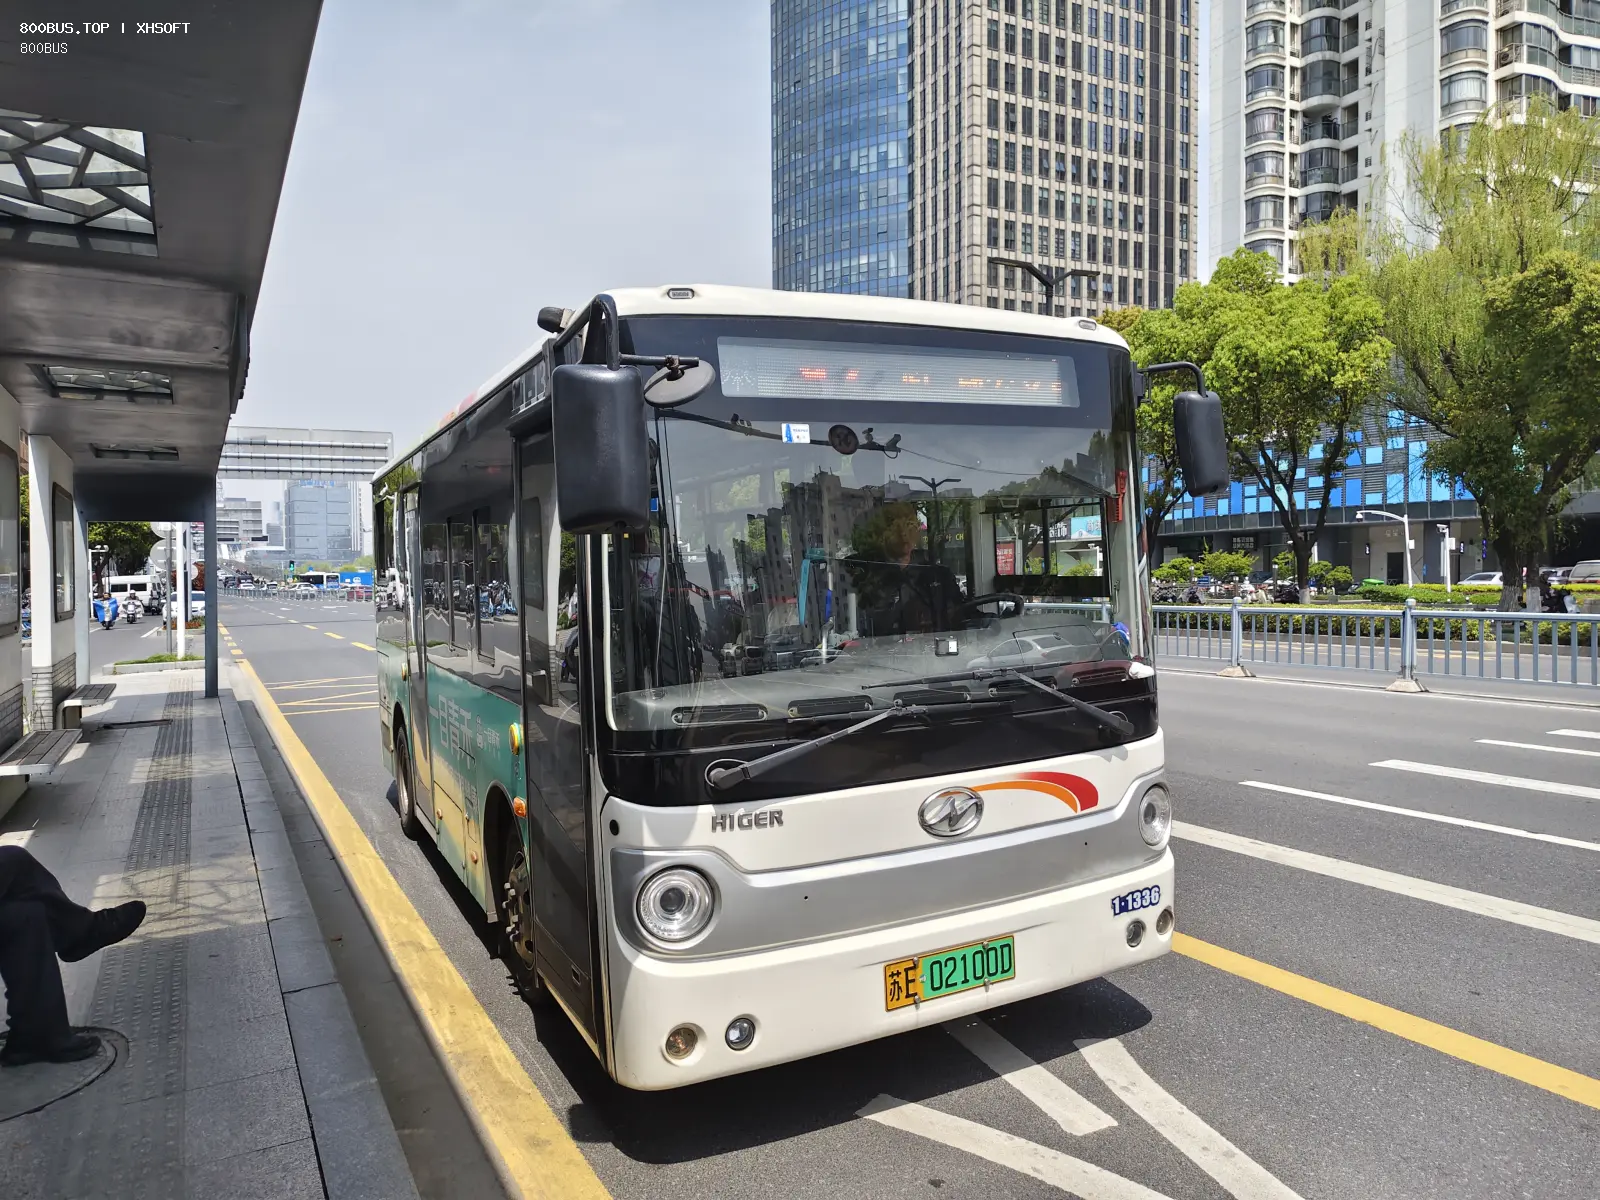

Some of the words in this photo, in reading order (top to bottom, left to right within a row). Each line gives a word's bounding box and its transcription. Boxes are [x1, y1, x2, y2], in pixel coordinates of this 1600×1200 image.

[711, 809, 784, 833] HIGER
[888, 963, 918, 1003] 苏E
[929, 942, 1013, 992] 02100D
